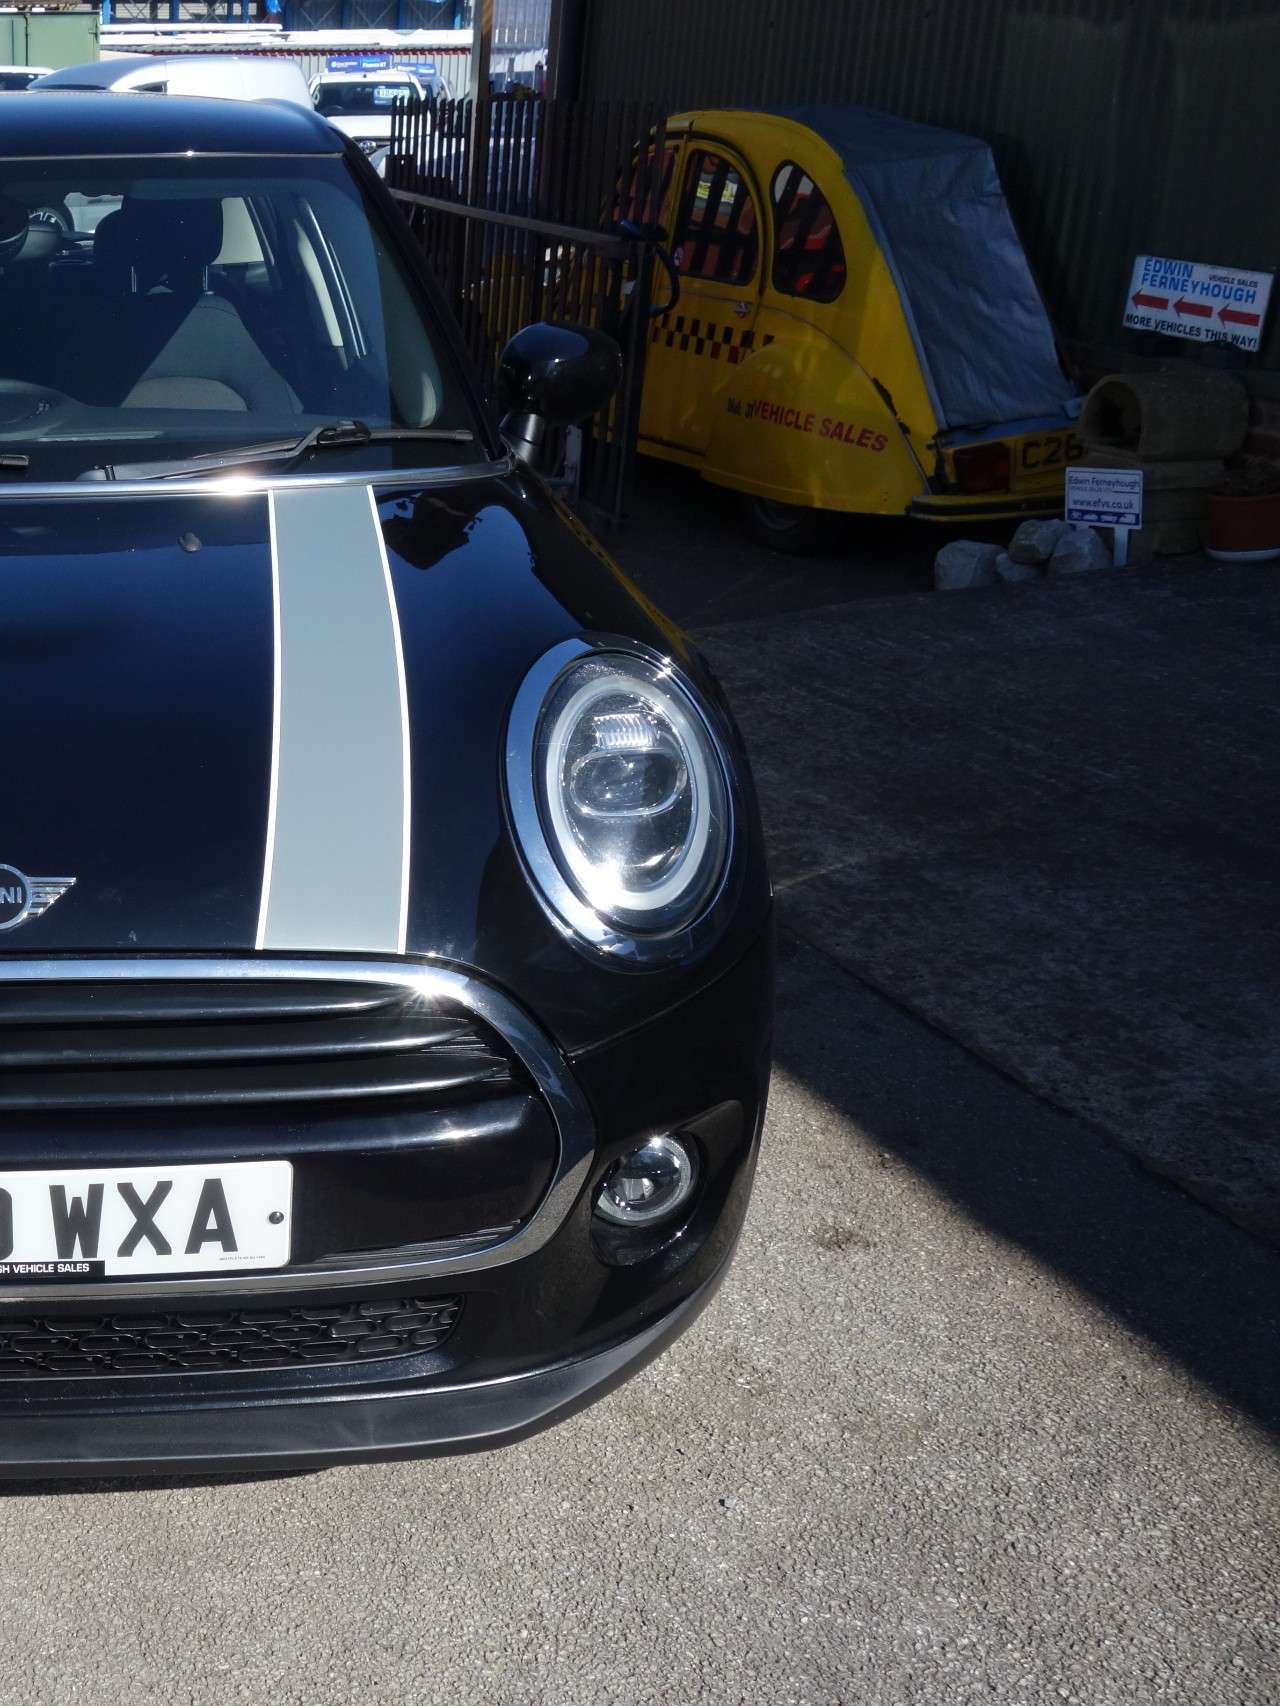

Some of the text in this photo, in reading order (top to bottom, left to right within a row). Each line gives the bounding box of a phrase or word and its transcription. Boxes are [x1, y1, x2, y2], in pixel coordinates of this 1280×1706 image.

[1143, 257, 1194, 279] EDWIN
[1141, 272, 1258, 305] FERNEYHOUGH
[1125, 313, 1258, 349] MORE VEHICLES THIS WAY!
[751, 399, 815, 433] VEHICLE
[818, 416, 889, 453] SALES
[48, 1178, 239, 1259] WXA
[13, 1263, 55, 1274] VEHICLE
[57, 1263, 90, 1273] SALES
